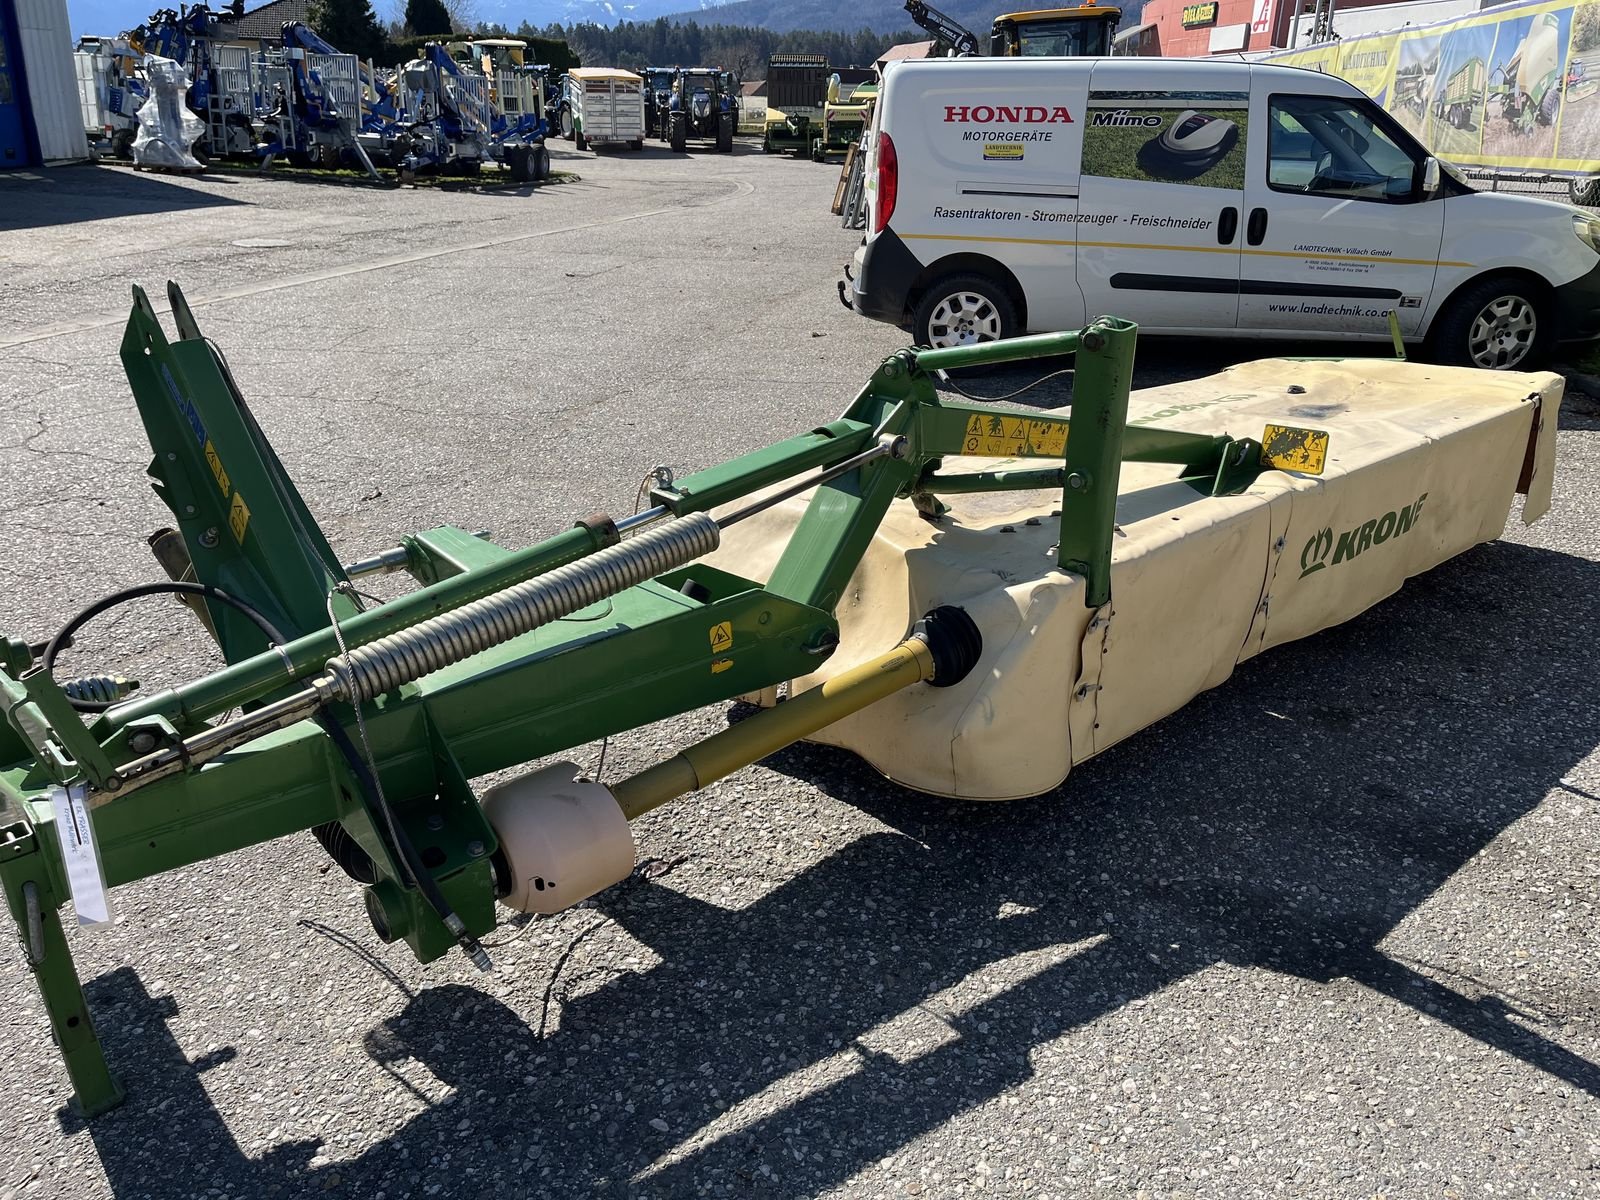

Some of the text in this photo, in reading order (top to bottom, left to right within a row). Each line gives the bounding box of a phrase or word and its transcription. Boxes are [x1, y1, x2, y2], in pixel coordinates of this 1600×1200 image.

[944, 106, 1074, 123] HONDA
[1092, 110, 1163, 127] Miimo
[962, 130, 1053, 141] MOTORGERÄTE
[933, 206, 1021, 221] Rasentraktoren
[1031, 209, 1118, 226] Stromerzeuger
[1130, 214, 1213, 230] Freischneider
[1370, 249, 1393, 257] GmbH
[1331, 492, 1429, 566] KRONE
